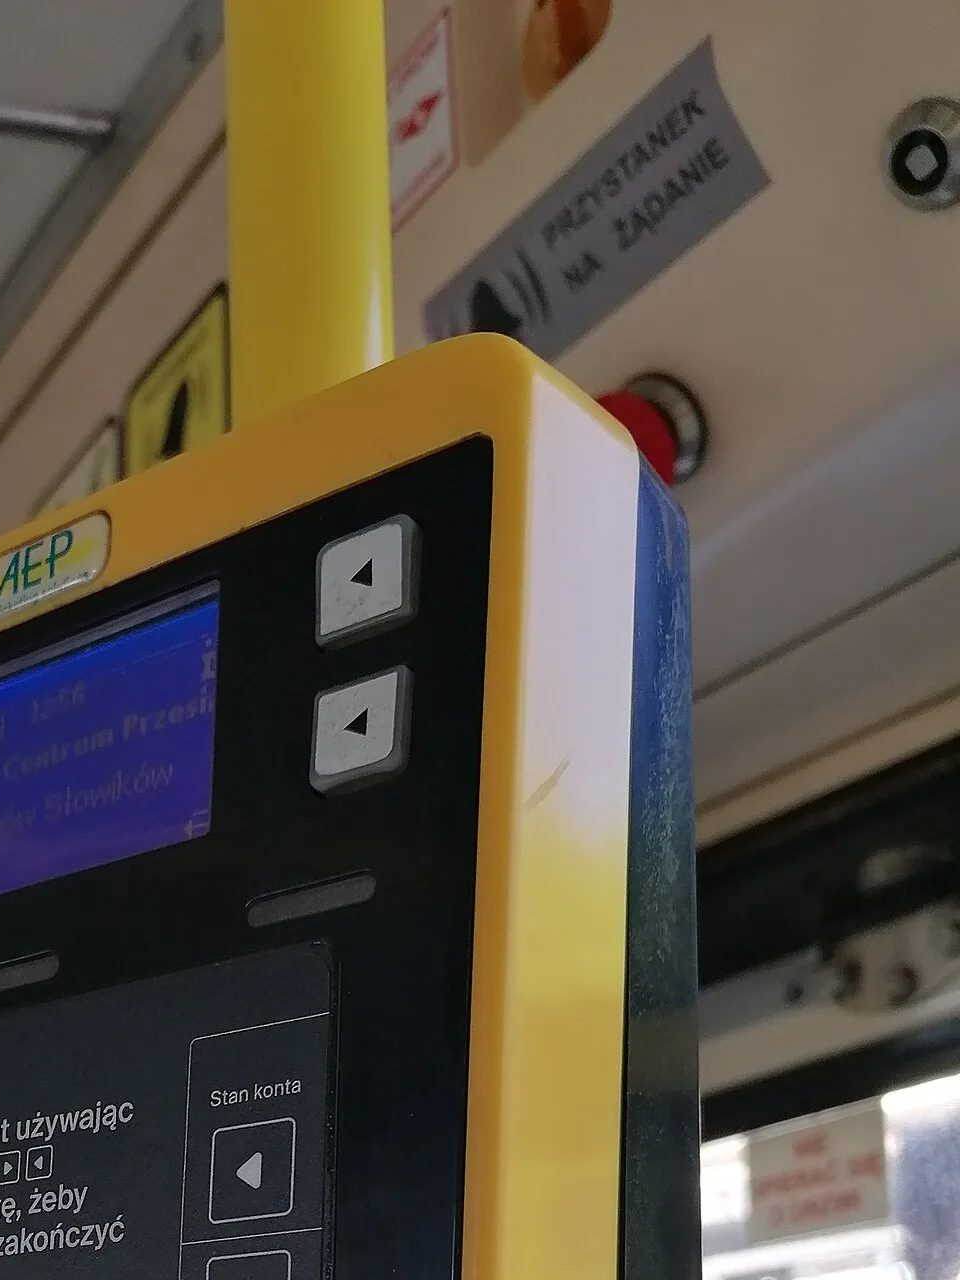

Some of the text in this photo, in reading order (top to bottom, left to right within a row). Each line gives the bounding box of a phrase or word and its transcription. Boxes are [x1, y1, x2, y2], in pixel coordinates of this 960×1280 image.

[542, 89, 705, 250] PRZYSTANEK
[561, 251, 601, 291] NA
[210, 1077, 302, 1108] Stan konta
[16, 1100, 134, 1141] używając
[28, 1183, 88, 1215] żeby
